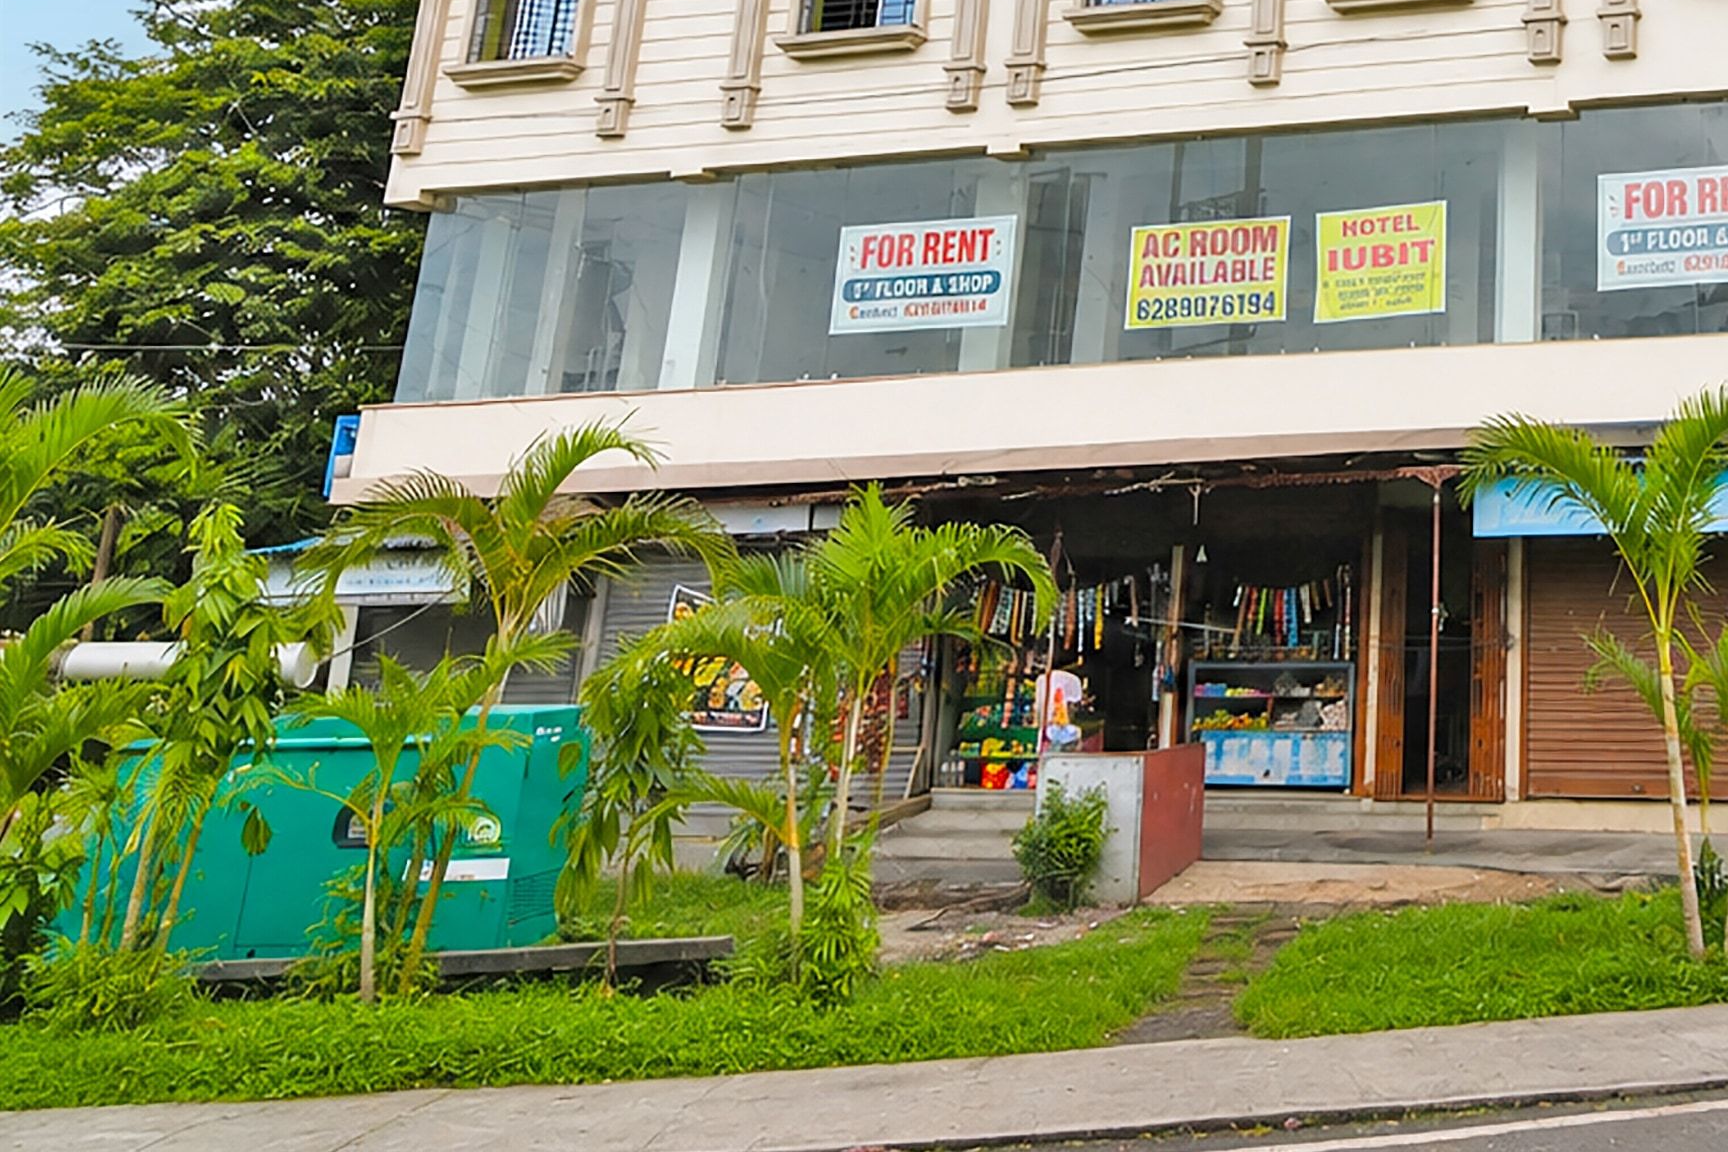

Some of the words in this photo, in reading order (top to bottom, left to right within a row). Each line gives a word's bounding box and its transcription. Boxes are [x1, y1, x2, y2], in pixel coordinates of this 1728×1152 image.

[1624, 179, 1688, 220] FOR
[1142, 231, 1181, 259] AC
[1190, 225, 1278, 258] ROOM
[1341, 214, 1421, 238] HOTEL
[859, 233, 916, 270] FOR
[922, 228, 995, 266] RENT
[1328, 238, 1435, 272] IUBIT
[1139, 257, 1276, 289] AVAILABLE
[1136, 290, 1276, 321] 6289076194
